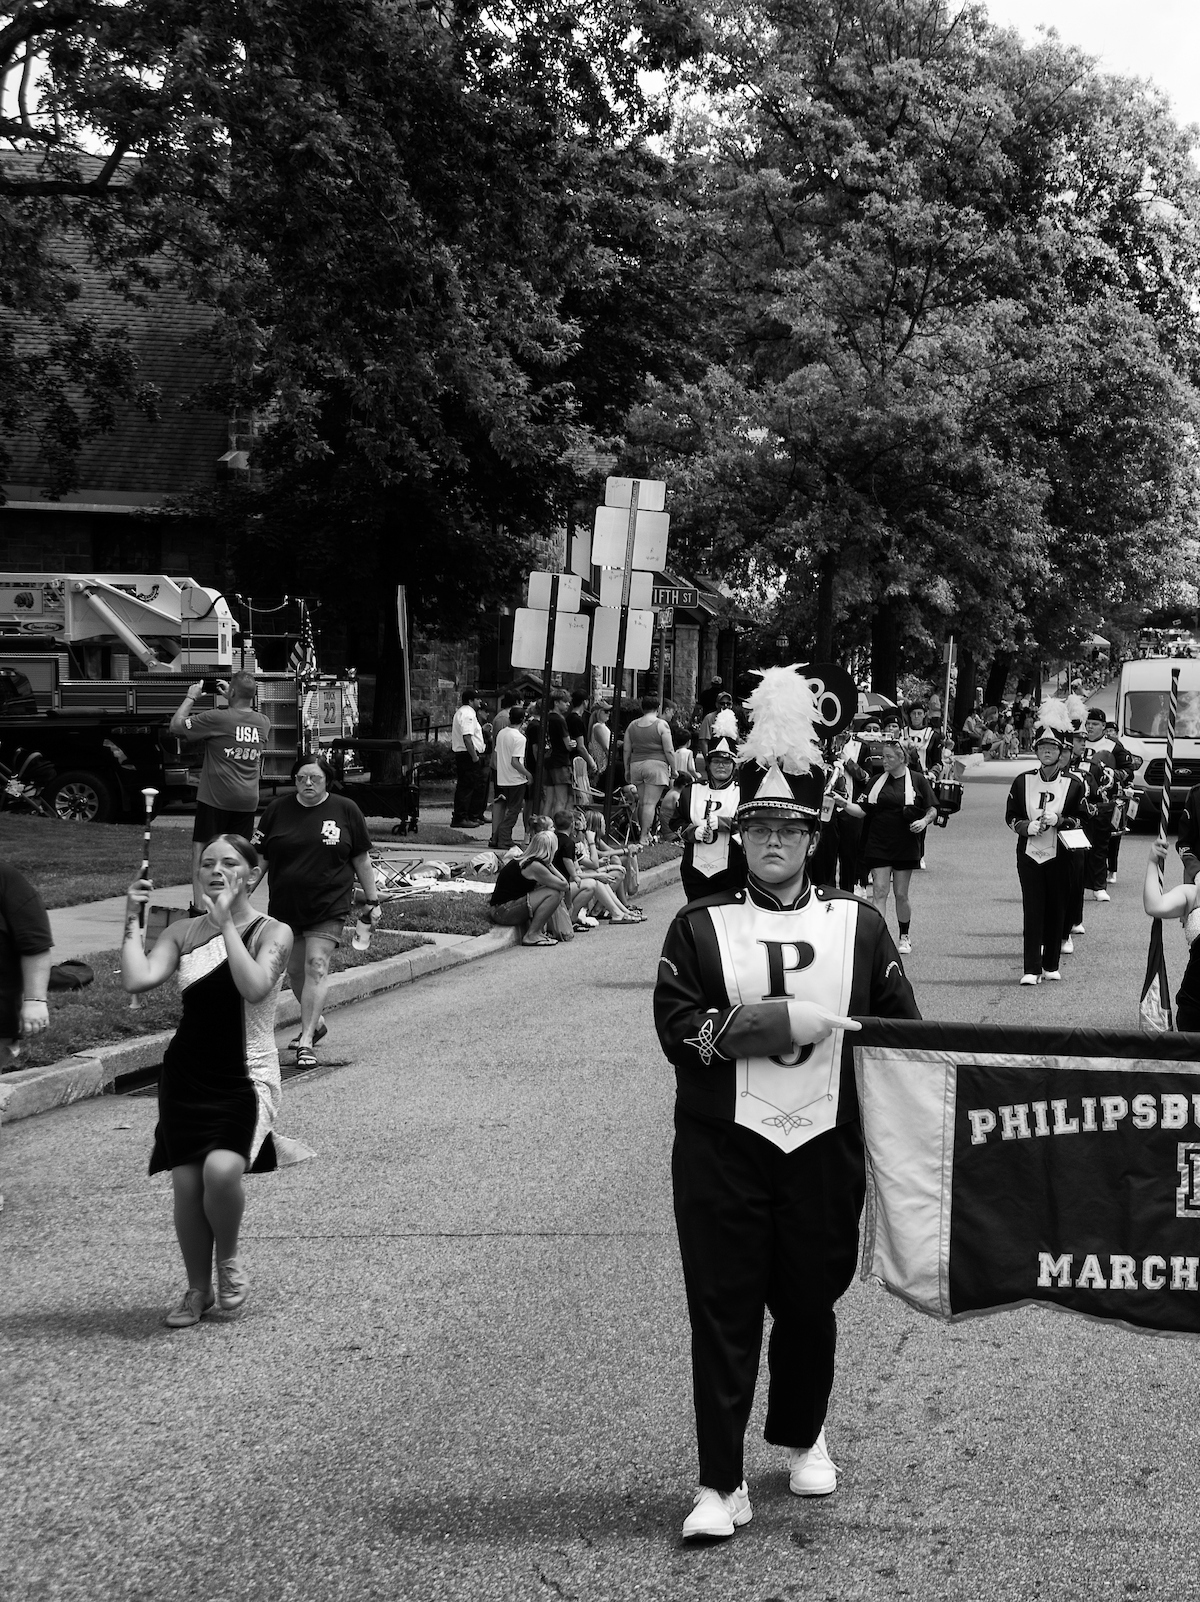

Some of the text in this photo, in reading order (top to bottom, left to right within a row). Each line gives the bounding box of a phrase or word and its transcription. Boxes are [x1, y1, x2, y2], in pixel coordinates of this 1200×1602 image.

[654, 589, 692, 605] IFTH ST
[323, 702, 336, 724] 22
[236, 726, 259, 743] USA
[234, 747, 257, 760] 250
[701, 799, 722, 821] P
[1036, 791, 1055, 810] P
[756, 938, 817, 1001] P
